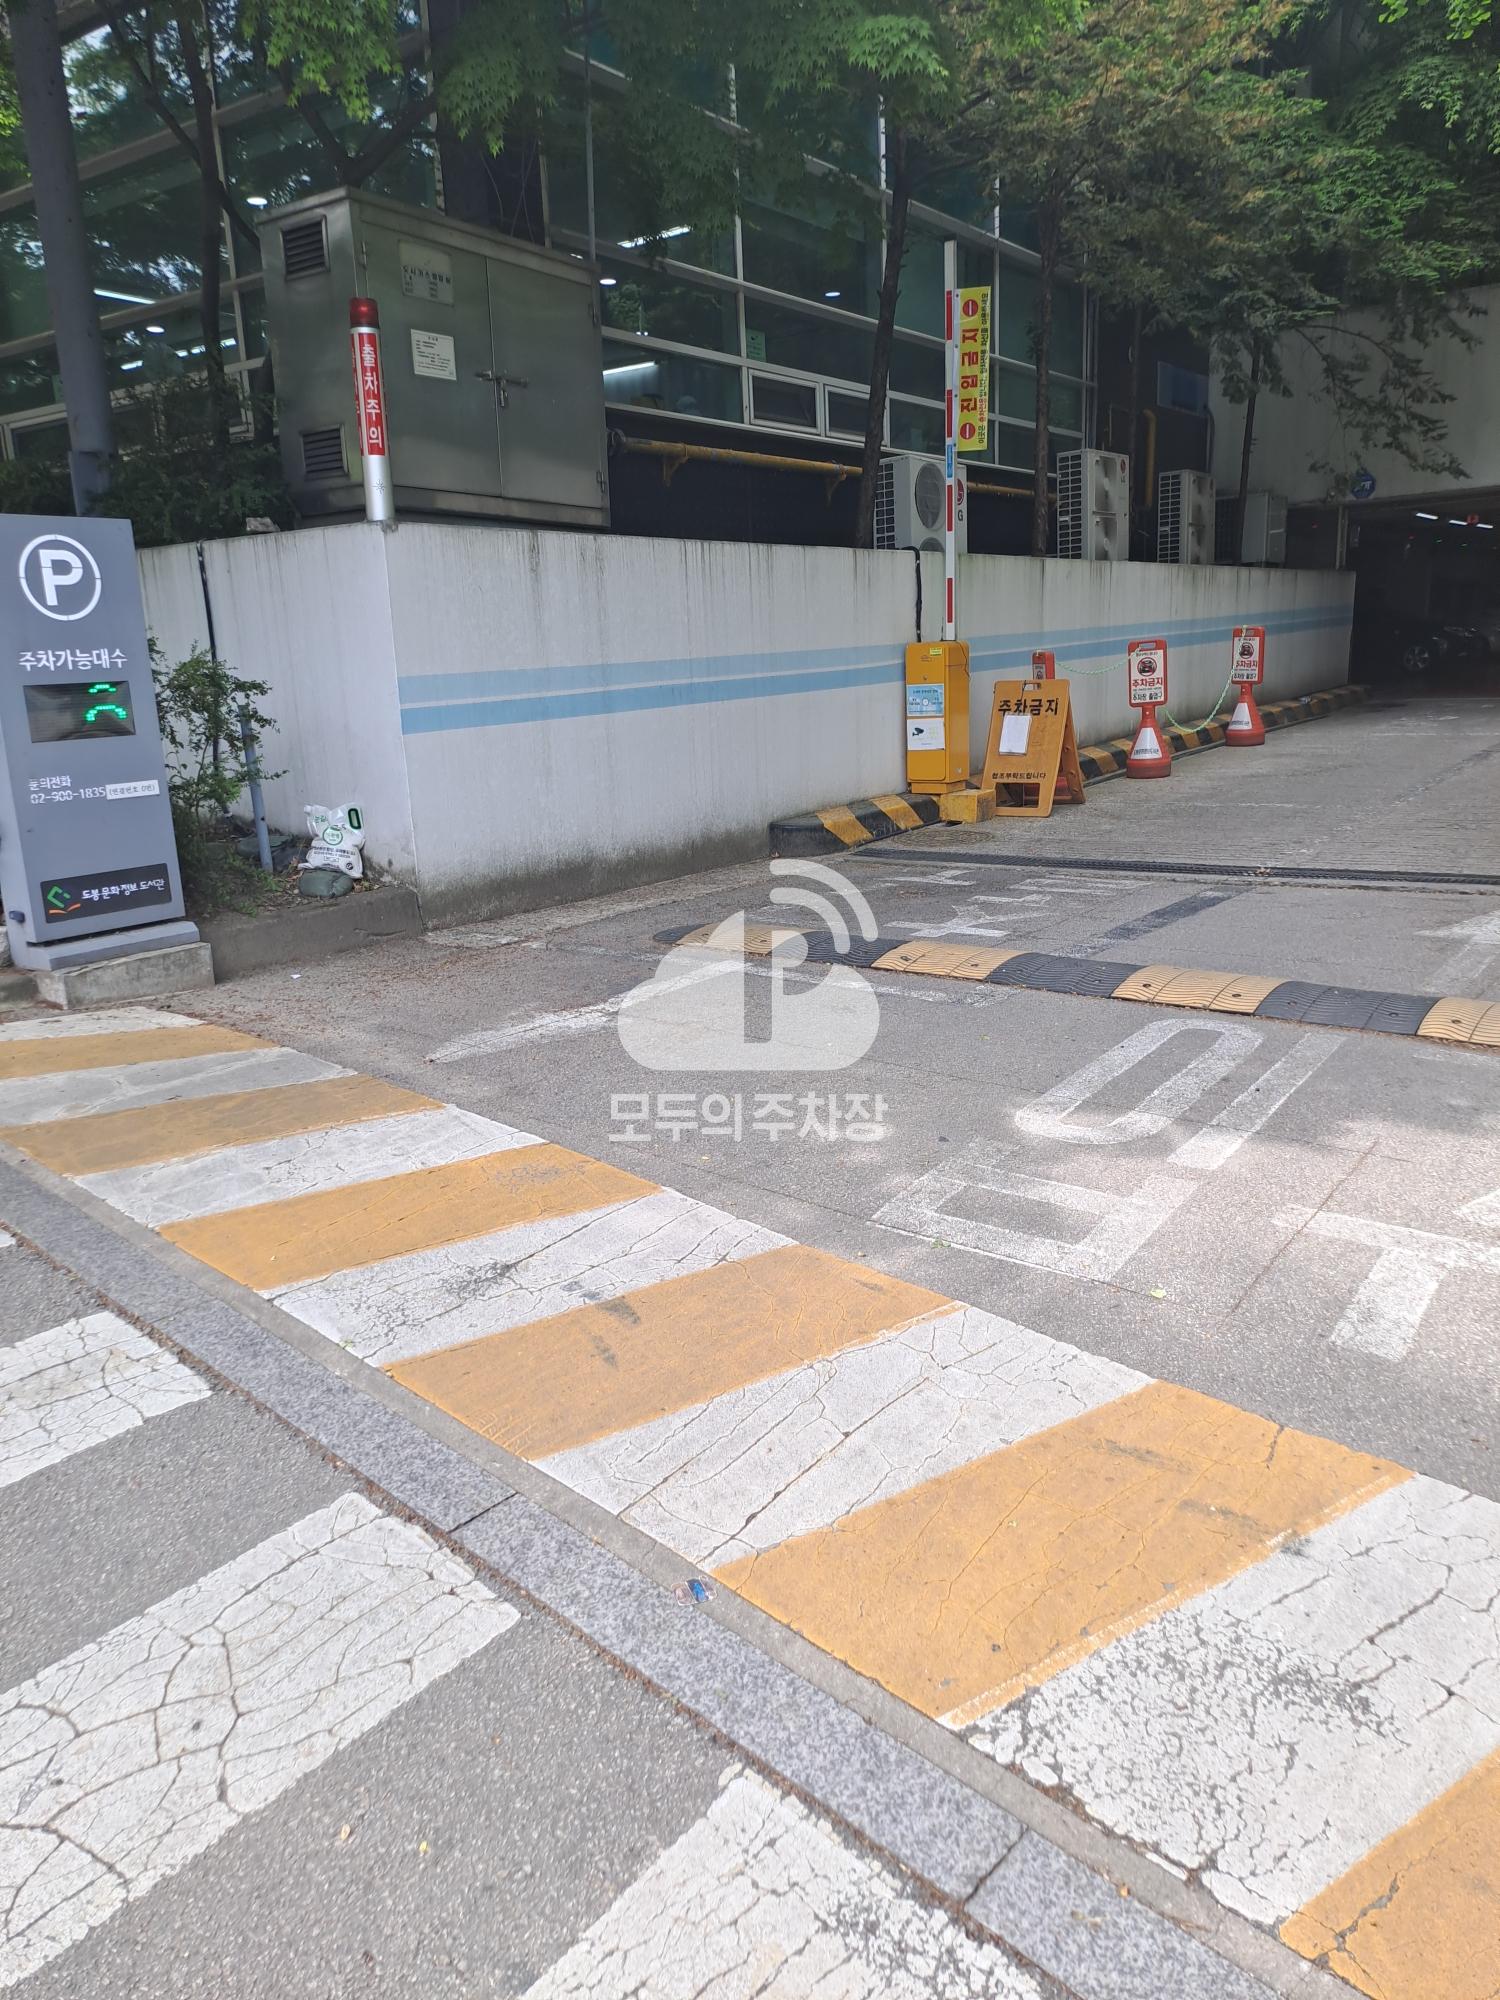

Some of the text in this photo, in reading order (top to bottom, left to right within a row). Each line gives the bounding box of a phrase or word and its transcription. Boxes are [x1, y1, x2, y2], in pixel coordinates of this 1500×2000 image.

[960, 328, 979, 413] 진입금지
[361, 343, 383, 448] 출차주의
[978, 425, 986, 444] 이곳은
[38, 549, 85, 606] P
[18, 648, 128, 671] 주차가능대수
[1132, 677, 1163, 687] 주차금지
[997, 697, 1059, 716] 주차금지
[28, 775, 73, 791] 문의전화
[991, 771, 1047, 780] 협조부탁드립니다
[30, 786, 106, 805] 02-900-1835
